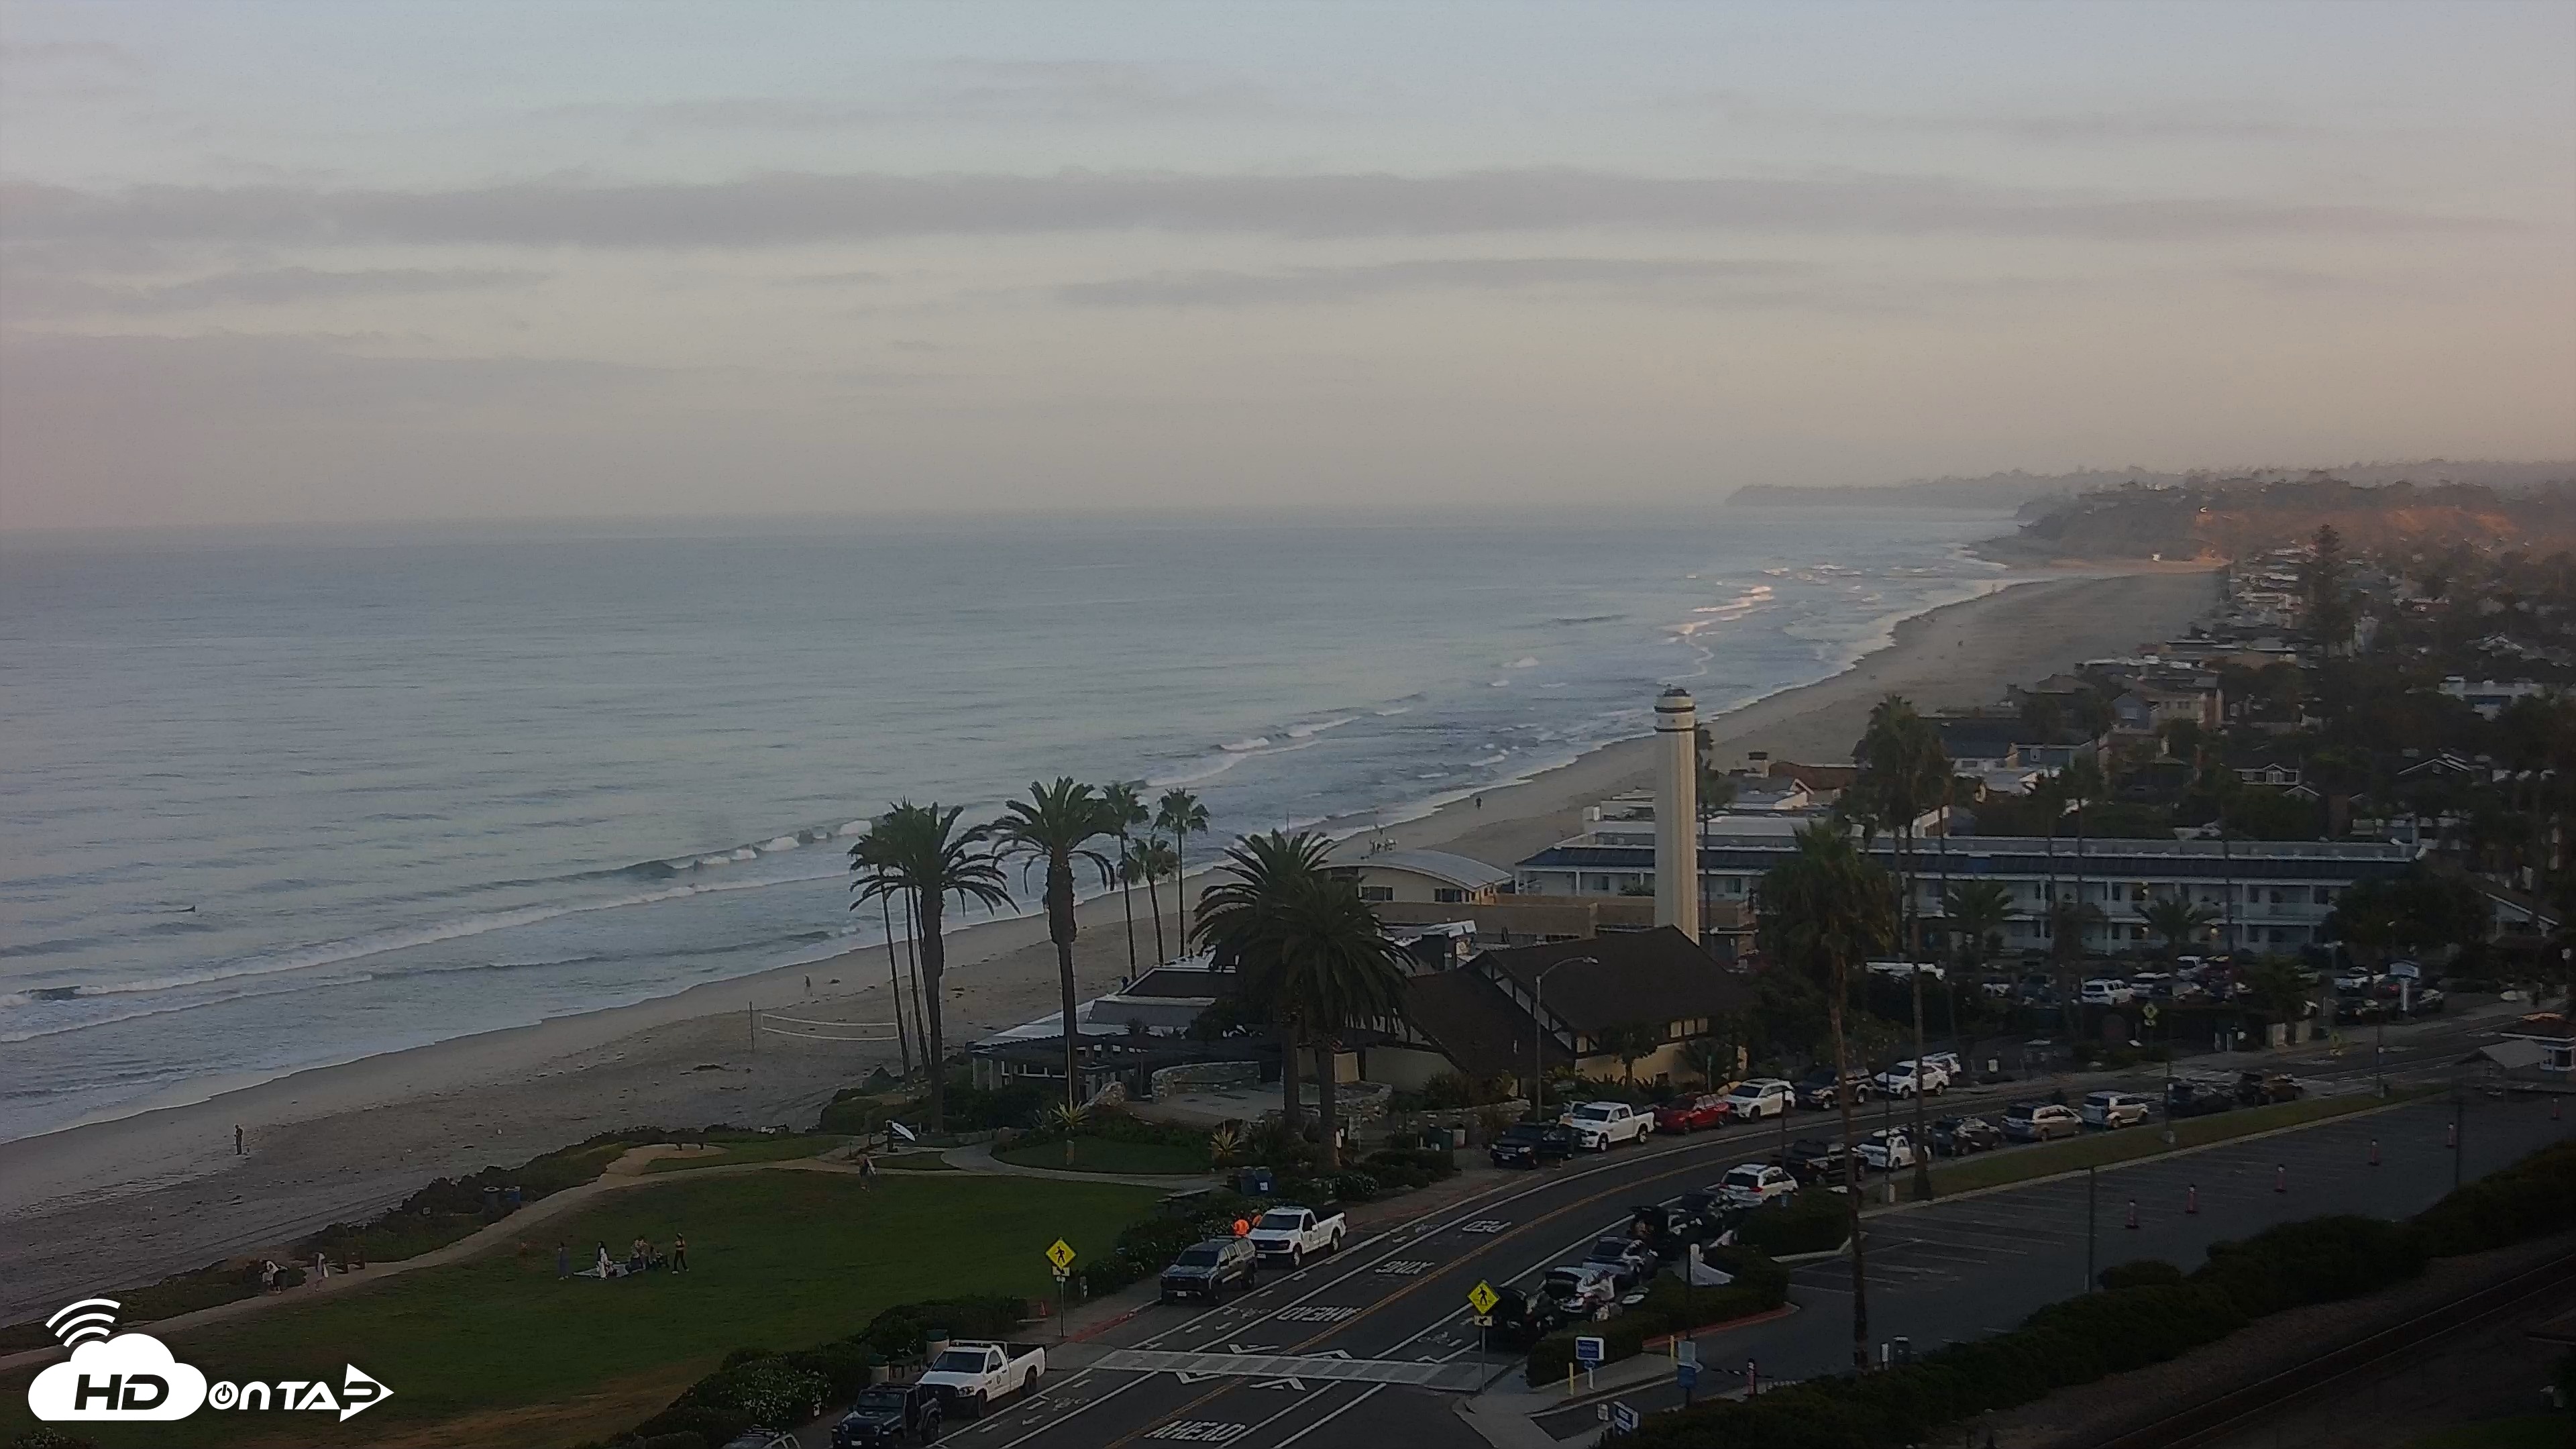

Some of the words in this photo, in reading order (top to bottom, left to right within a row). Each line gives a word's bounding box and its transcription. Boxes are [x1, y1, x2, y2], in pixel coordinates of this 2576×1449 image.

[1462, 1220, 1511, 1233] PED
[1375, 1260, 1435, 1275] XING
[1277, 1307, 1362, 1322] AHEAD
[1144, 1420, 1246, 1441] AHEAD
